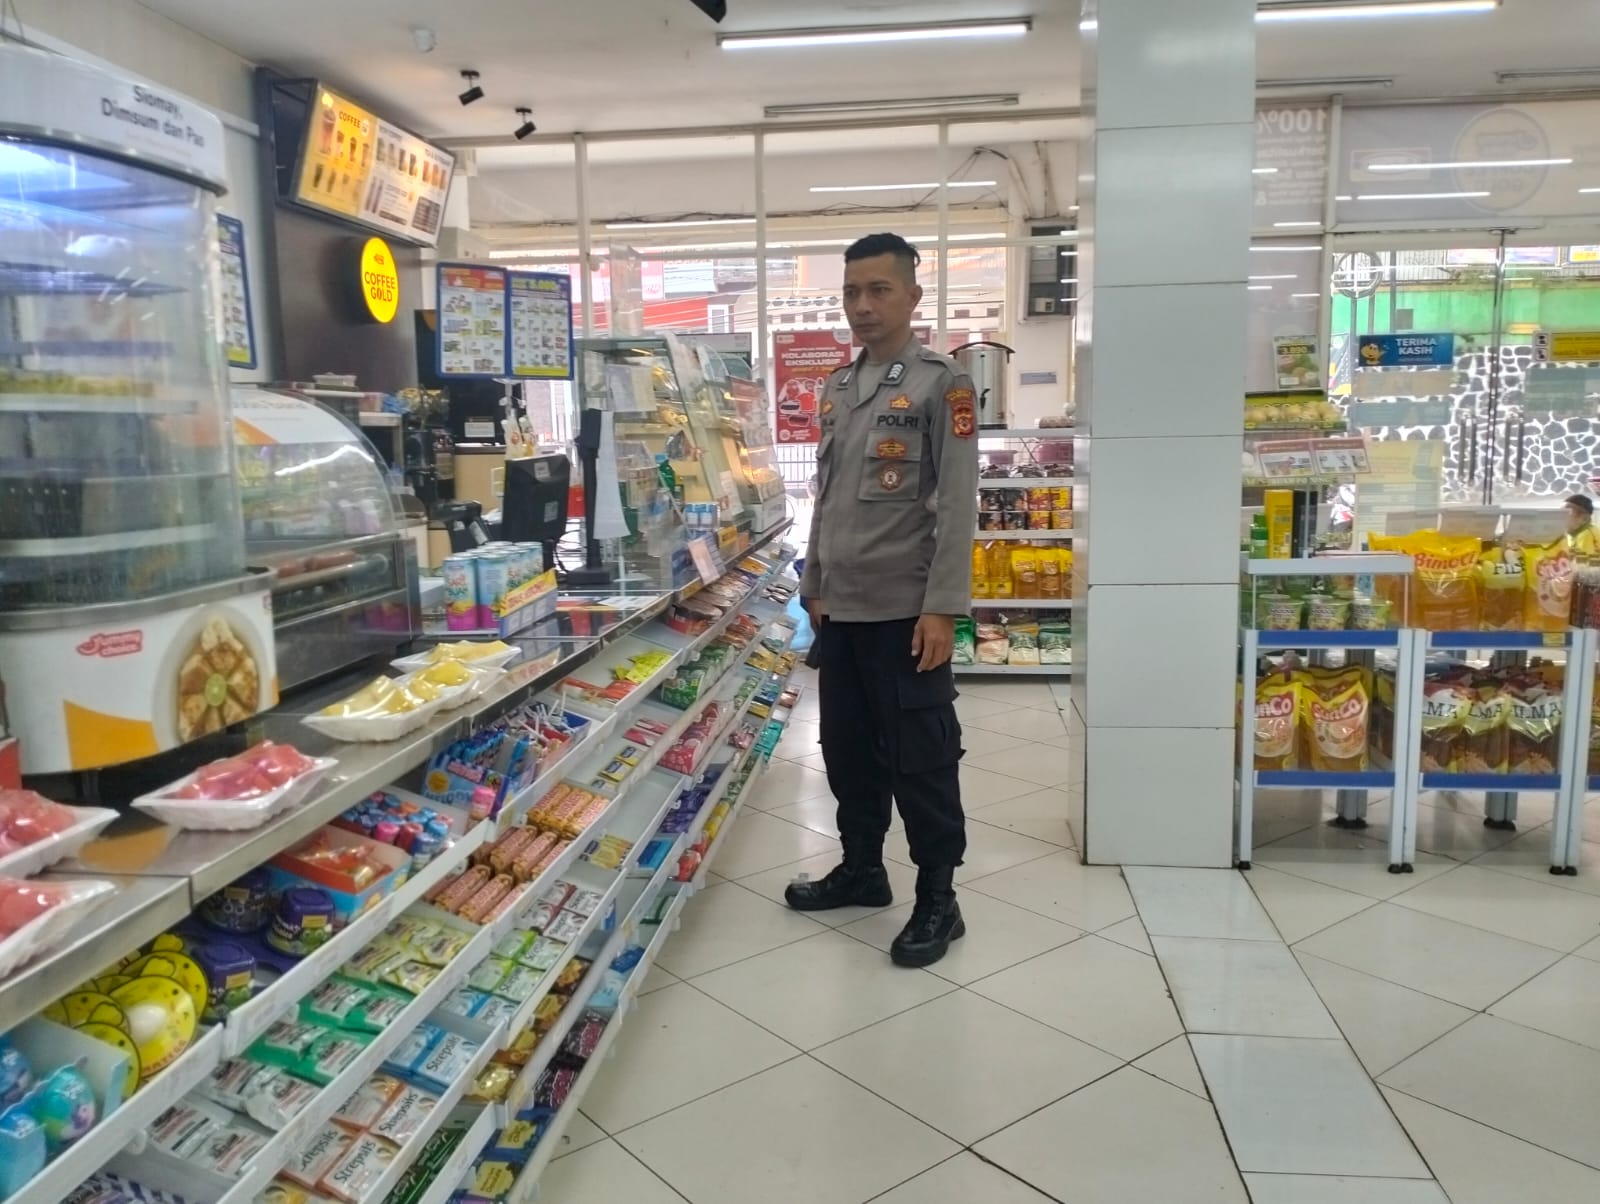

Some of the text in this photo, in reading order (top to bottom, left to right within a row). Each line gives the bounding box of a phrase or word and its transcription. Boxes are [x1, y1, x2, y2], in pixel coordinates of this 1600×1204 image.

[101, 97, 159, 132] Dimsum
[338, 110, 361, 129] COFFEE
[364, 271, 396, 290] COFFEE
[370, 286, 393, 302] GOLD
[1395, 337, 1438, 347] TERIMA
[781, 351, 845, 359] KOLABORASI
[1398, 346, 1433, 356] KASIH
[784, 358, 841, 367] EKSKLUSIF
[876, 414, 919, 428] POLRI
[425, 1034, 461, 1073] Strepsils
[378, 1089, 418, 1132] Strepsils
[333, 1140, 377, 1183] Strepsils
